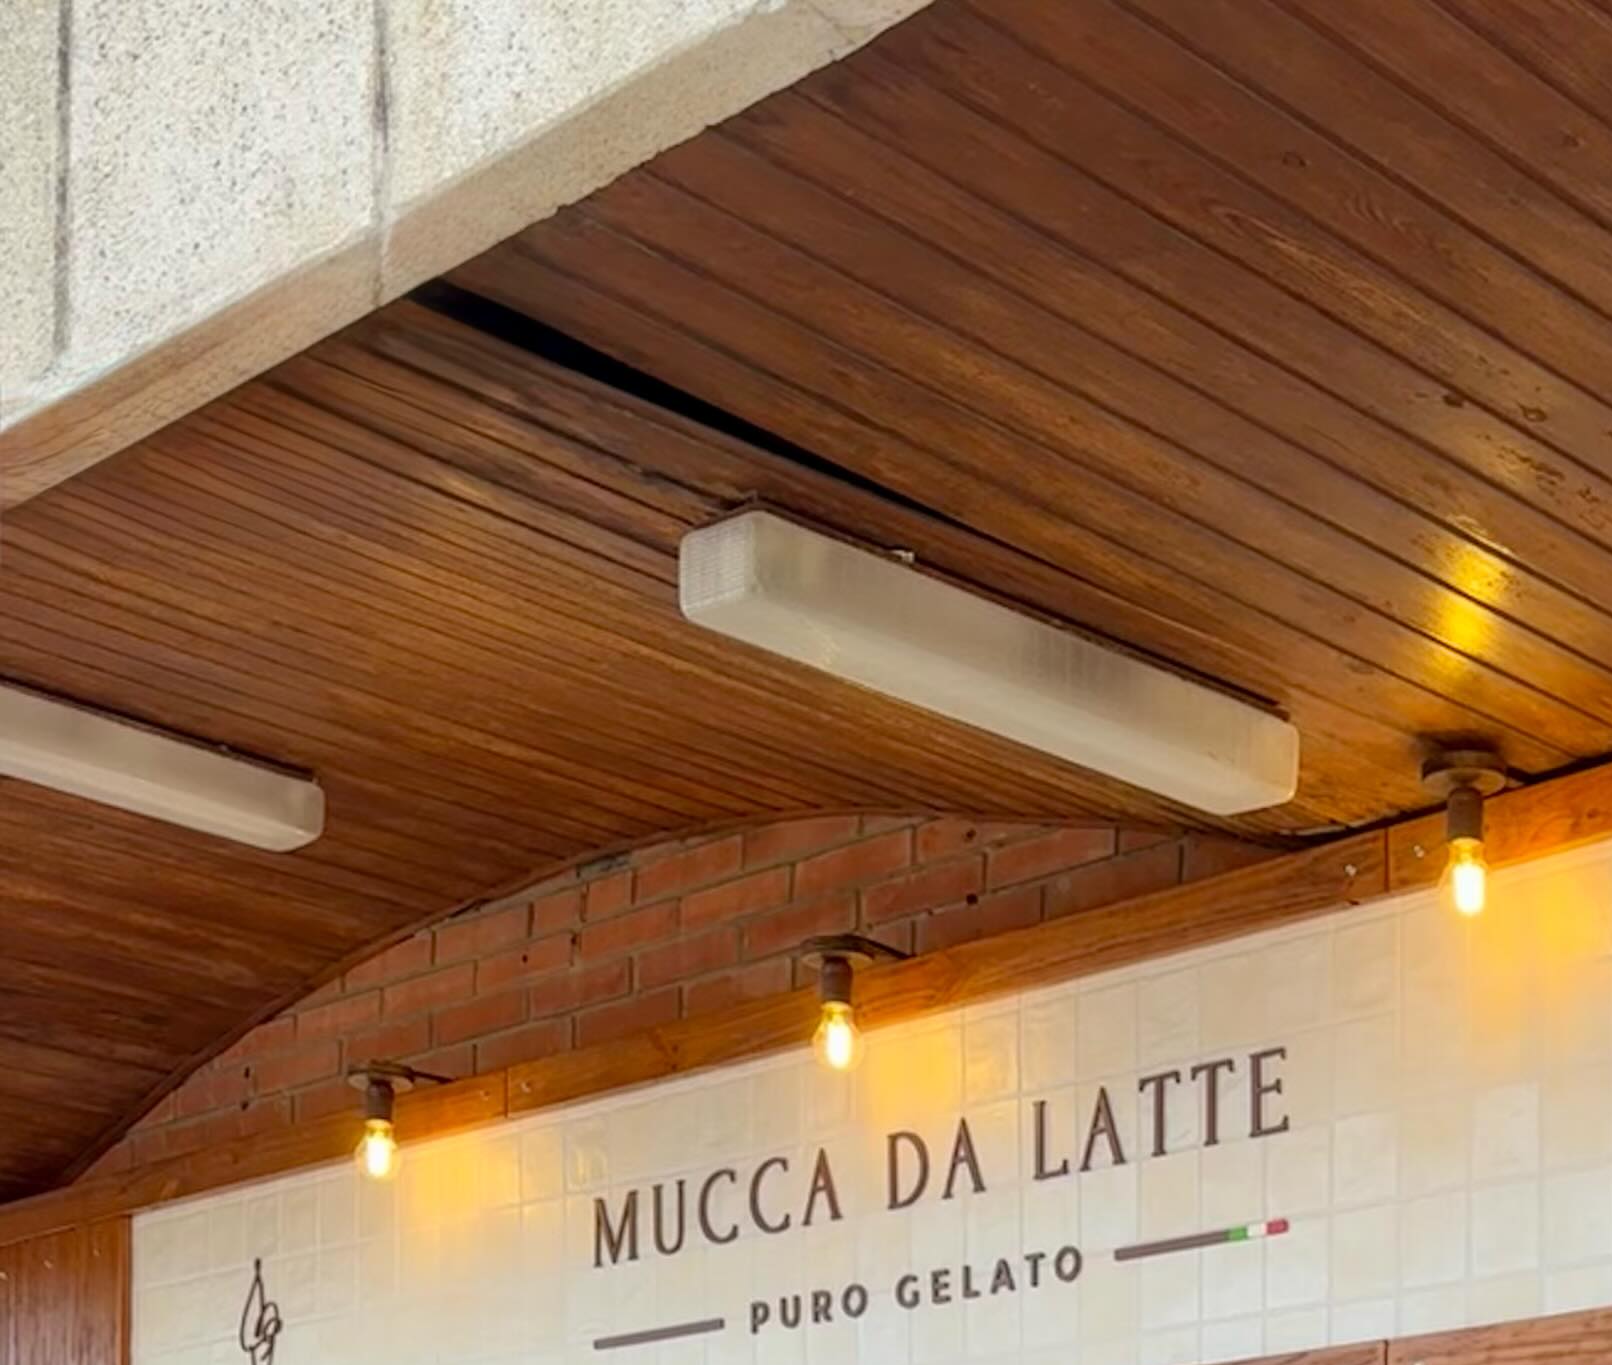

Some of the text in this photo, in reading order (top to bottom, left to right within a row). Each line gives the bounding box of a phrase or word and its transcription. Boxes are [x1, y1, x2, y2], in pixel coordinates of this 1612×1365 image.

[593, 1046, 1291, 1268] MUCCA DA LATTE
[750, 1245, 1084, 1334] PURO GELATO
